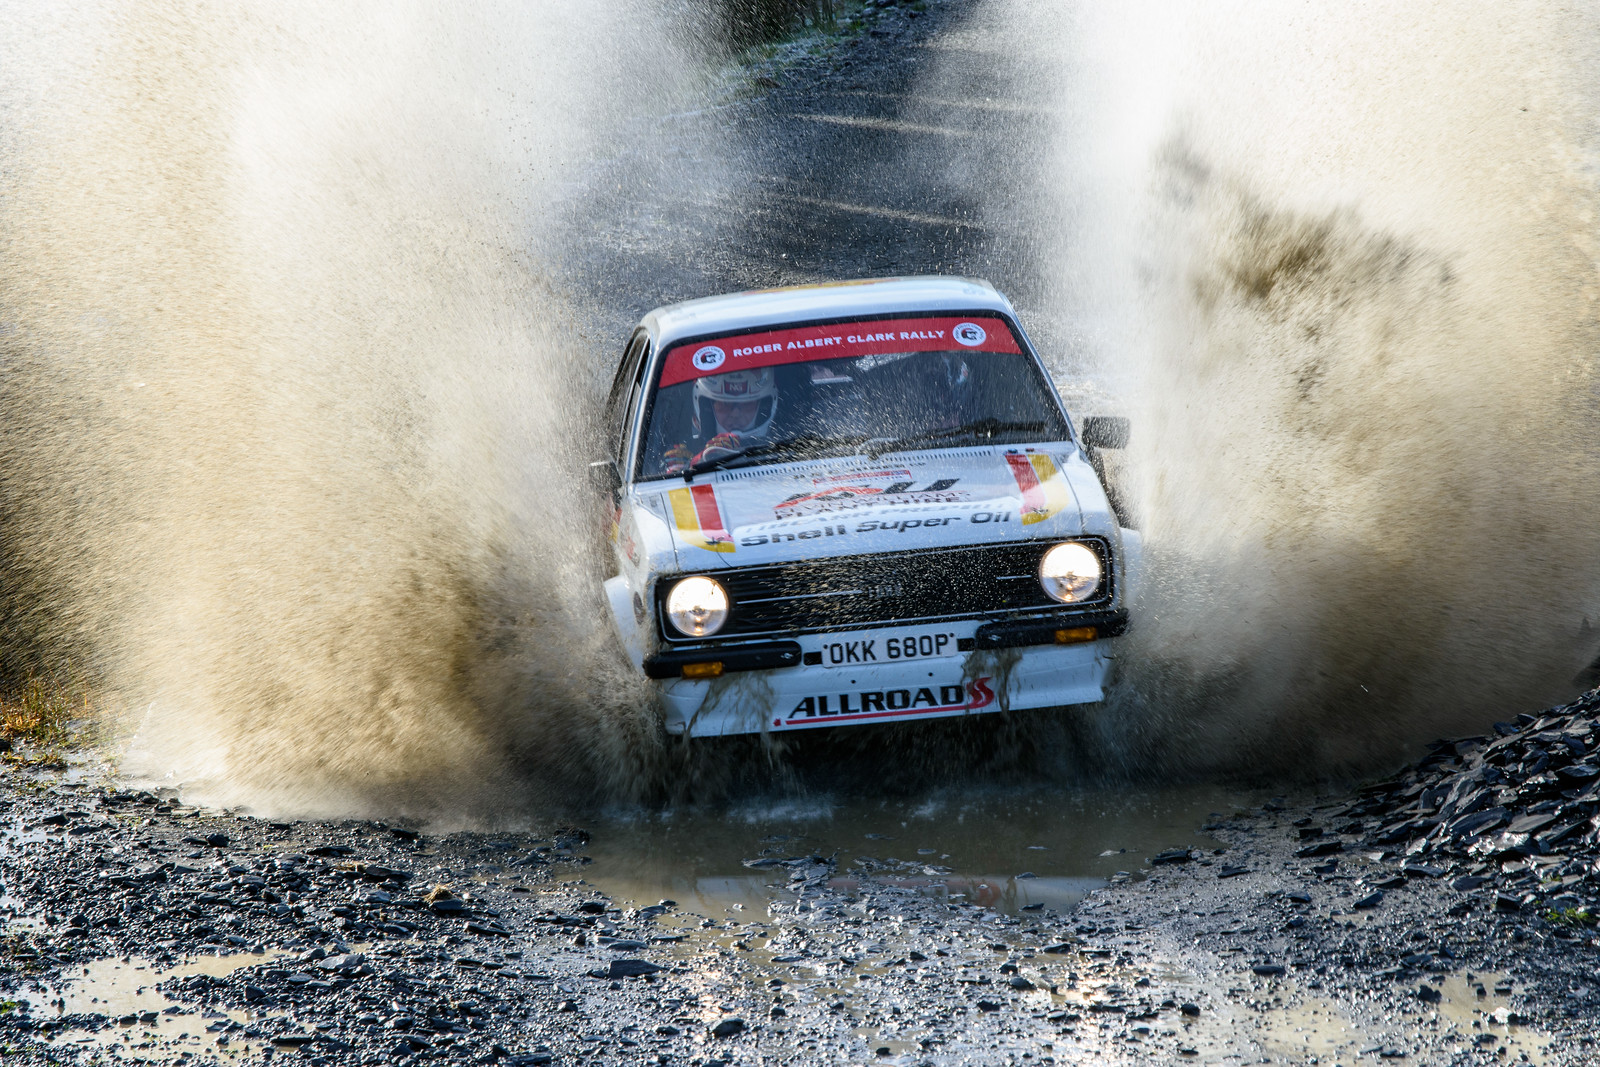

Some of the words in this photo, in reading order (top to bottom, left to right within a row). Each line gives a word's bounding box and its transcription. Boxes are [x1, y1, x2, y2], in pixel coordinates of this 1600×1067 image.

[732, 343, 783, 357] ROGER
[786, 336, 843, 350] ALBERT
[846, 332, 897, 344] CLARK
[899, 325, 945, 340] RALLY
[741, 525, 847, 547] Shell
[855, 517, 961, 533] Super
[970, 511, 1011, 524] Oil
[829, 640, 877, 664] OKK
[886, 633, 948, 659] 680P
